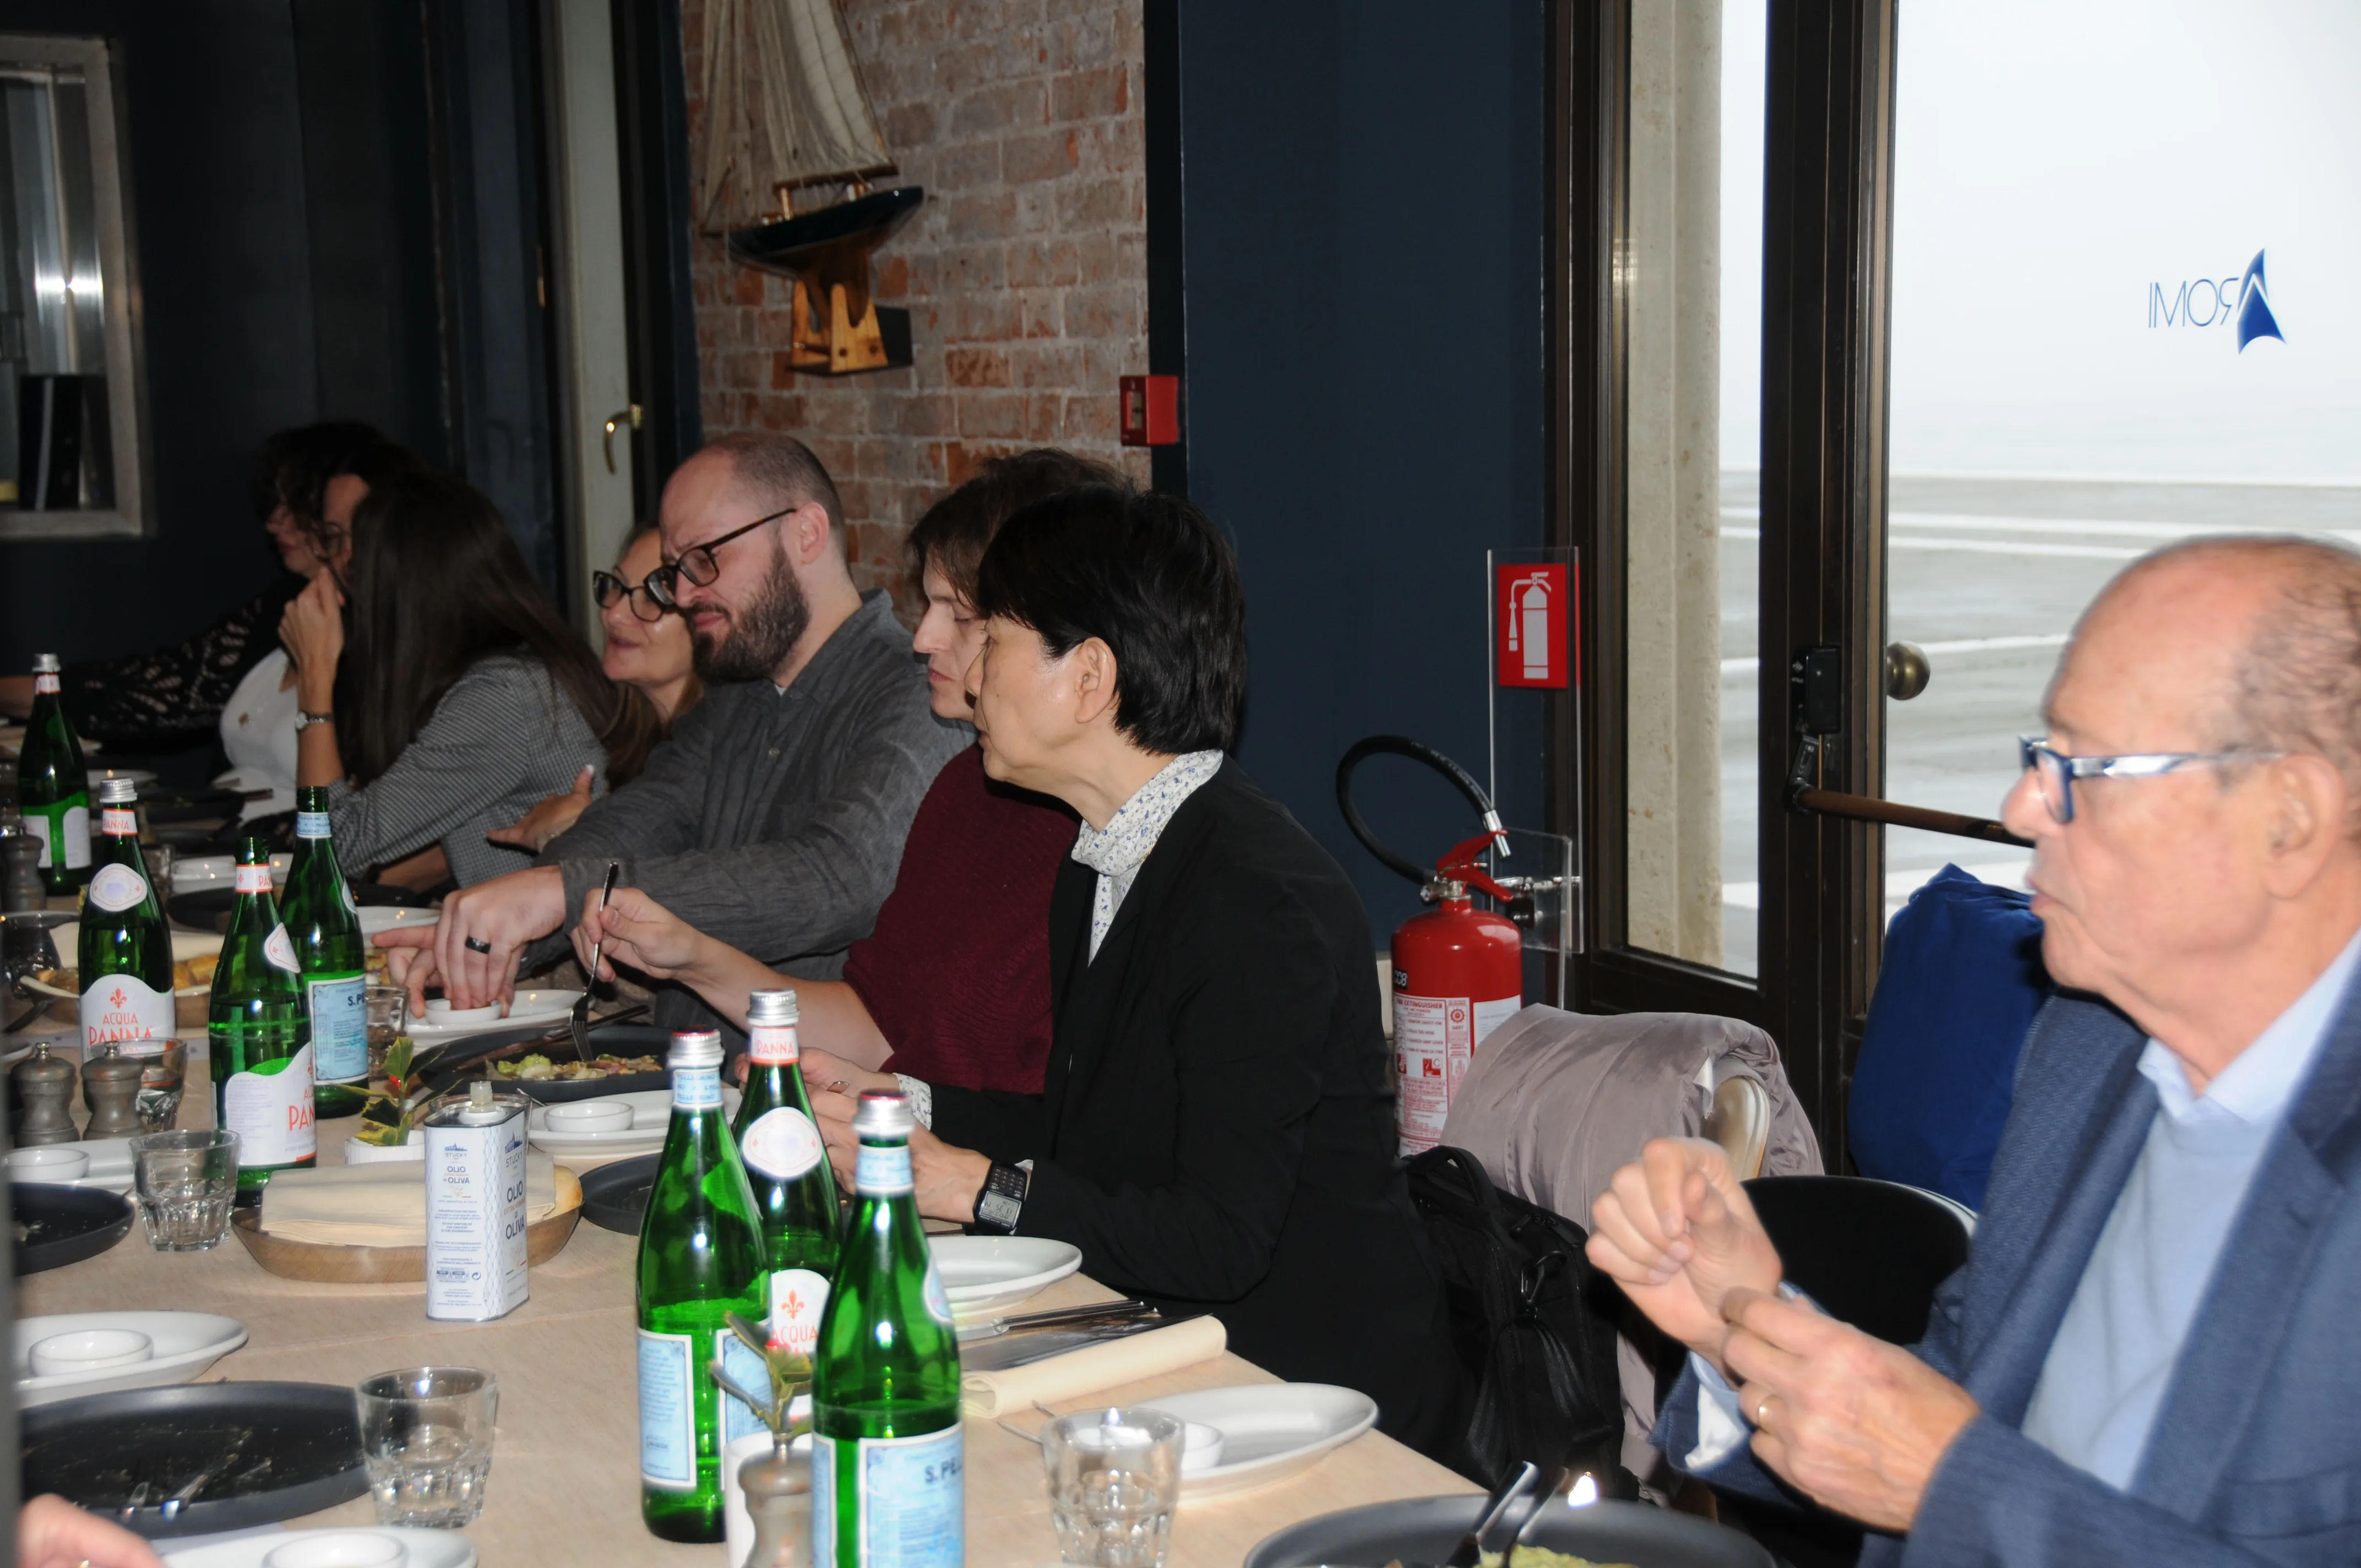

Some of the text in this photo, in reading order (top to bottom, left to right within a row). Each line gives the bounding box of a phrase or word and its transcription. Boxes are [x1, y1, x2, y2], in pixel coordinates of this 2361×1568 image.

[102, 1012, 138, 1025] ACQUA
[757, 1039, 795, 1055] PANNA
[507, 1180, 523, 1203] OLIO
[505, 1214, 525, 1240] OLIVA
[773, 1324, 819, 1344] ACQUA
